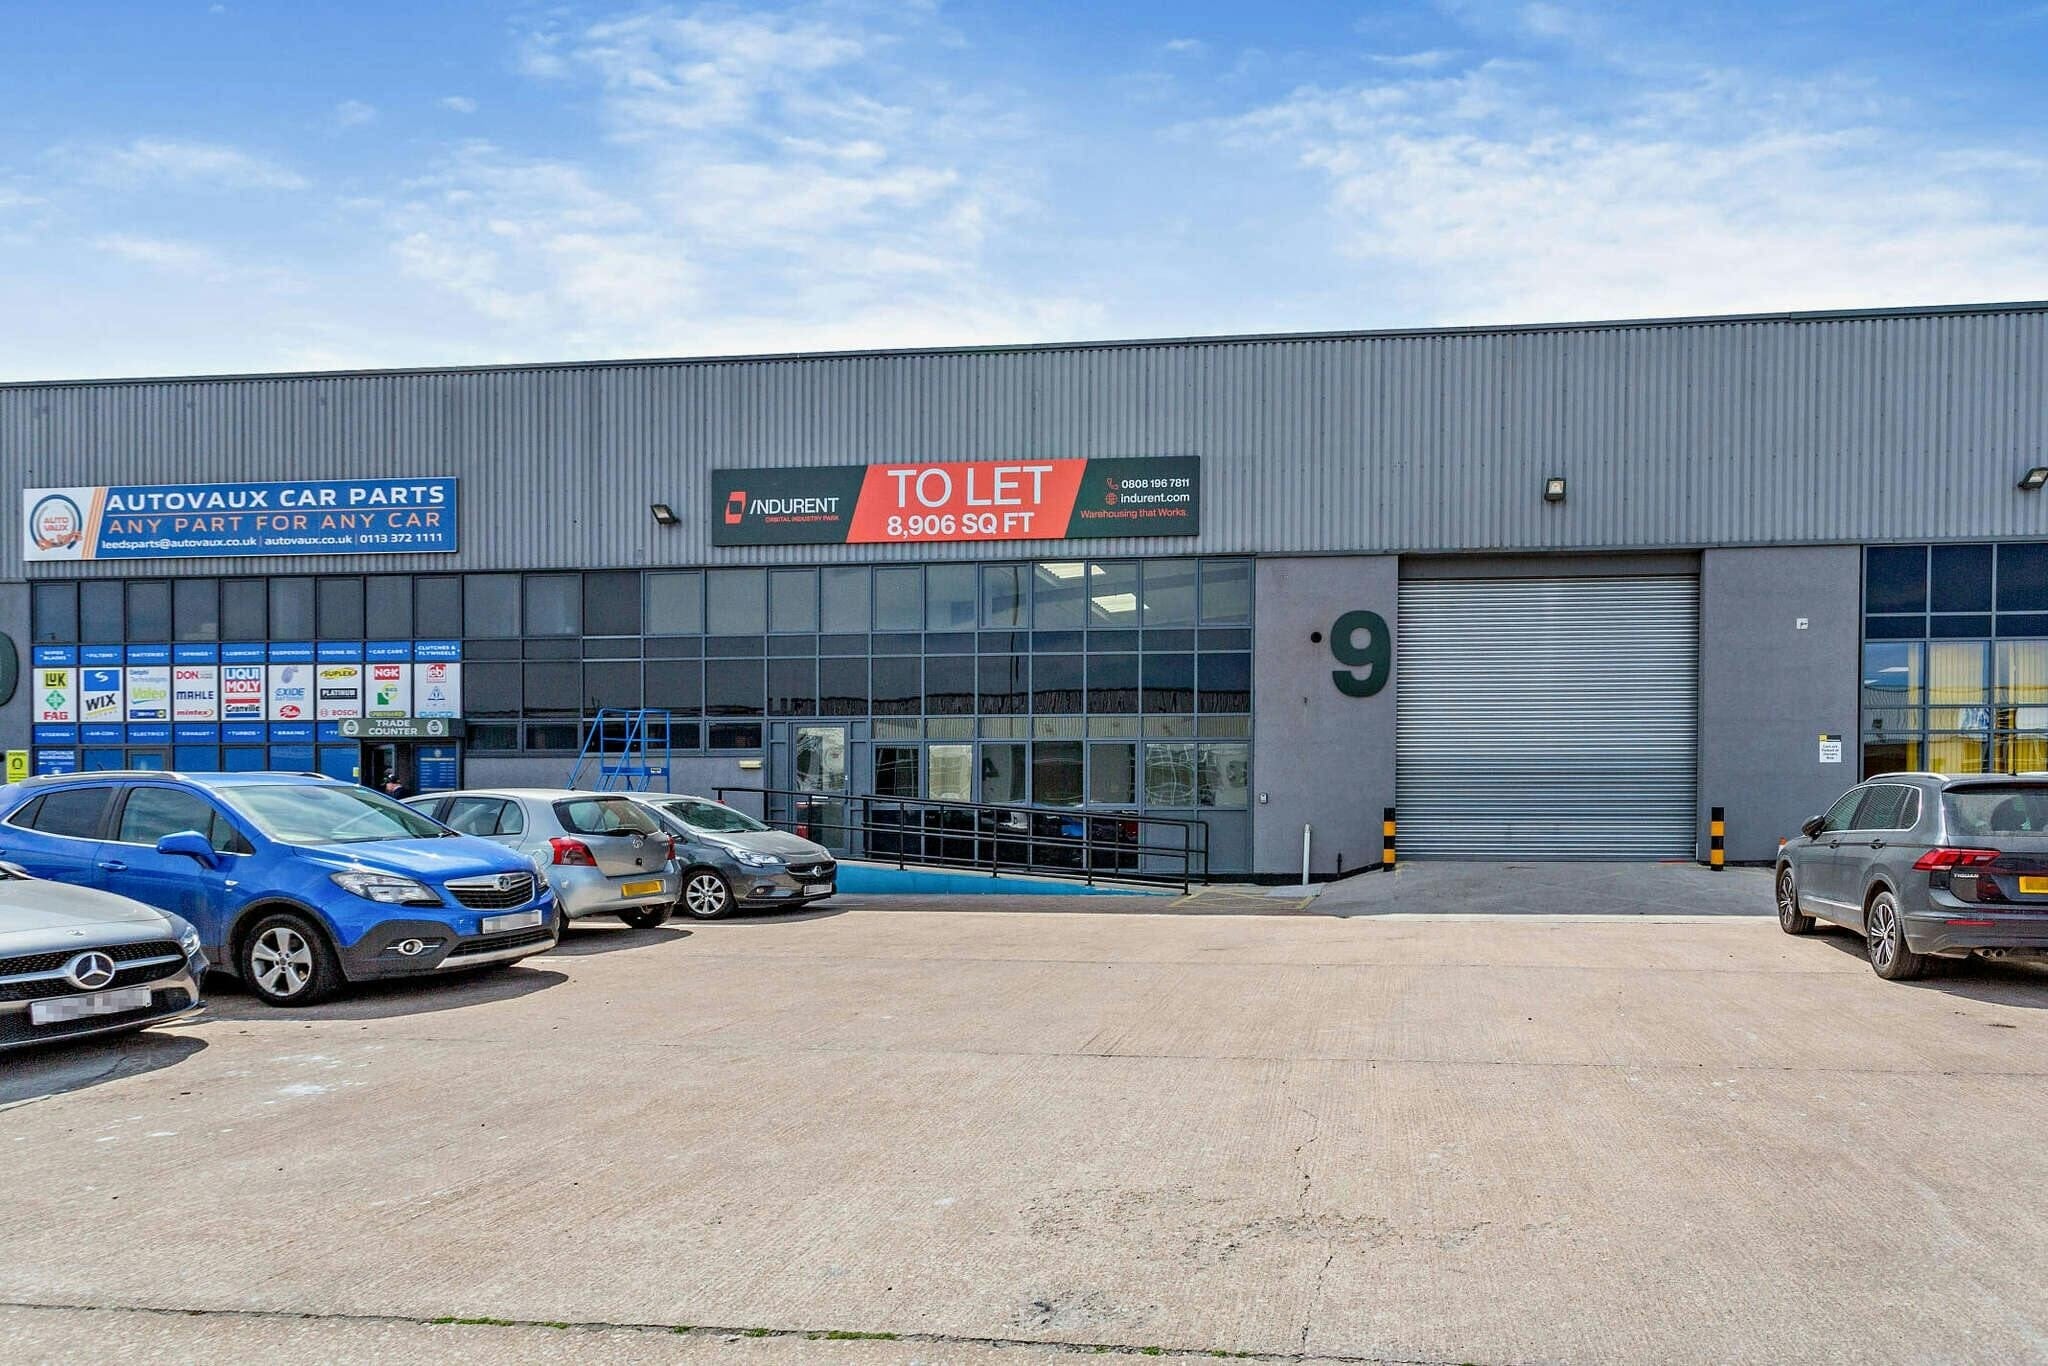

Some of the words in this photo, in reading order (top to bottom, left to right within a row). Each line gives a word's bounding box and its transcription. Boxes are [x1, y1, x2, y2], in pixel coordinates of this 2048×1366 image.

[888, 468, 953, 508] TO
[966, 465, 1053, 506] LET
[1121, 479, 1149, 489] 0808
[1150, 478, 1168, 489] 196
[1169, 478, 1190, 488] 7811
[106, 489, 269, 511] AUTOVAUX
[279, 489, 337, 507] CAR
[349, 486, 445, 505] PARTS
[1120, 493, 1190, 504] indurent.com
[1080, 509, 1138, 519] Warehousing
[1139, 508, 1156, 518] that
[108, 518, 162, 535] ANY
[174, 516, 244, 533] PART
[255, 515, 308, 531] FOR
[320, 513, 376, 530] ANY
[387, 512, 441, 528] CAR
[887, 514, 956, 538] 8,906
[961, 513, 997, 534] SQ
[1003, 511, 1035, 533] FT
[102, 536, 257, 551] leedsparts@autovaux.co.uk
[264, 534, 353, 546] autovaux.co.uk
[359, 534, 388, 544] 0113
[391, 533, 413, 543] 372
[416, 532, 443, 543] 1111
[1330, 610, 1391, 697] 9
[176, 670, 199, 680] DON
[225, 667, 260, 680] LIQUI
[375, 668, 400, 678] NGK
[225, 680, 260, 693] MOLY
[176, 690, 214, 700] MAHLE
[85, 693, 117, 711] WIX
[43, 711, 69, 720] FAG
[375, 719, 411, 727] TRADE
[368, 728, 418, 736] COUNTER
